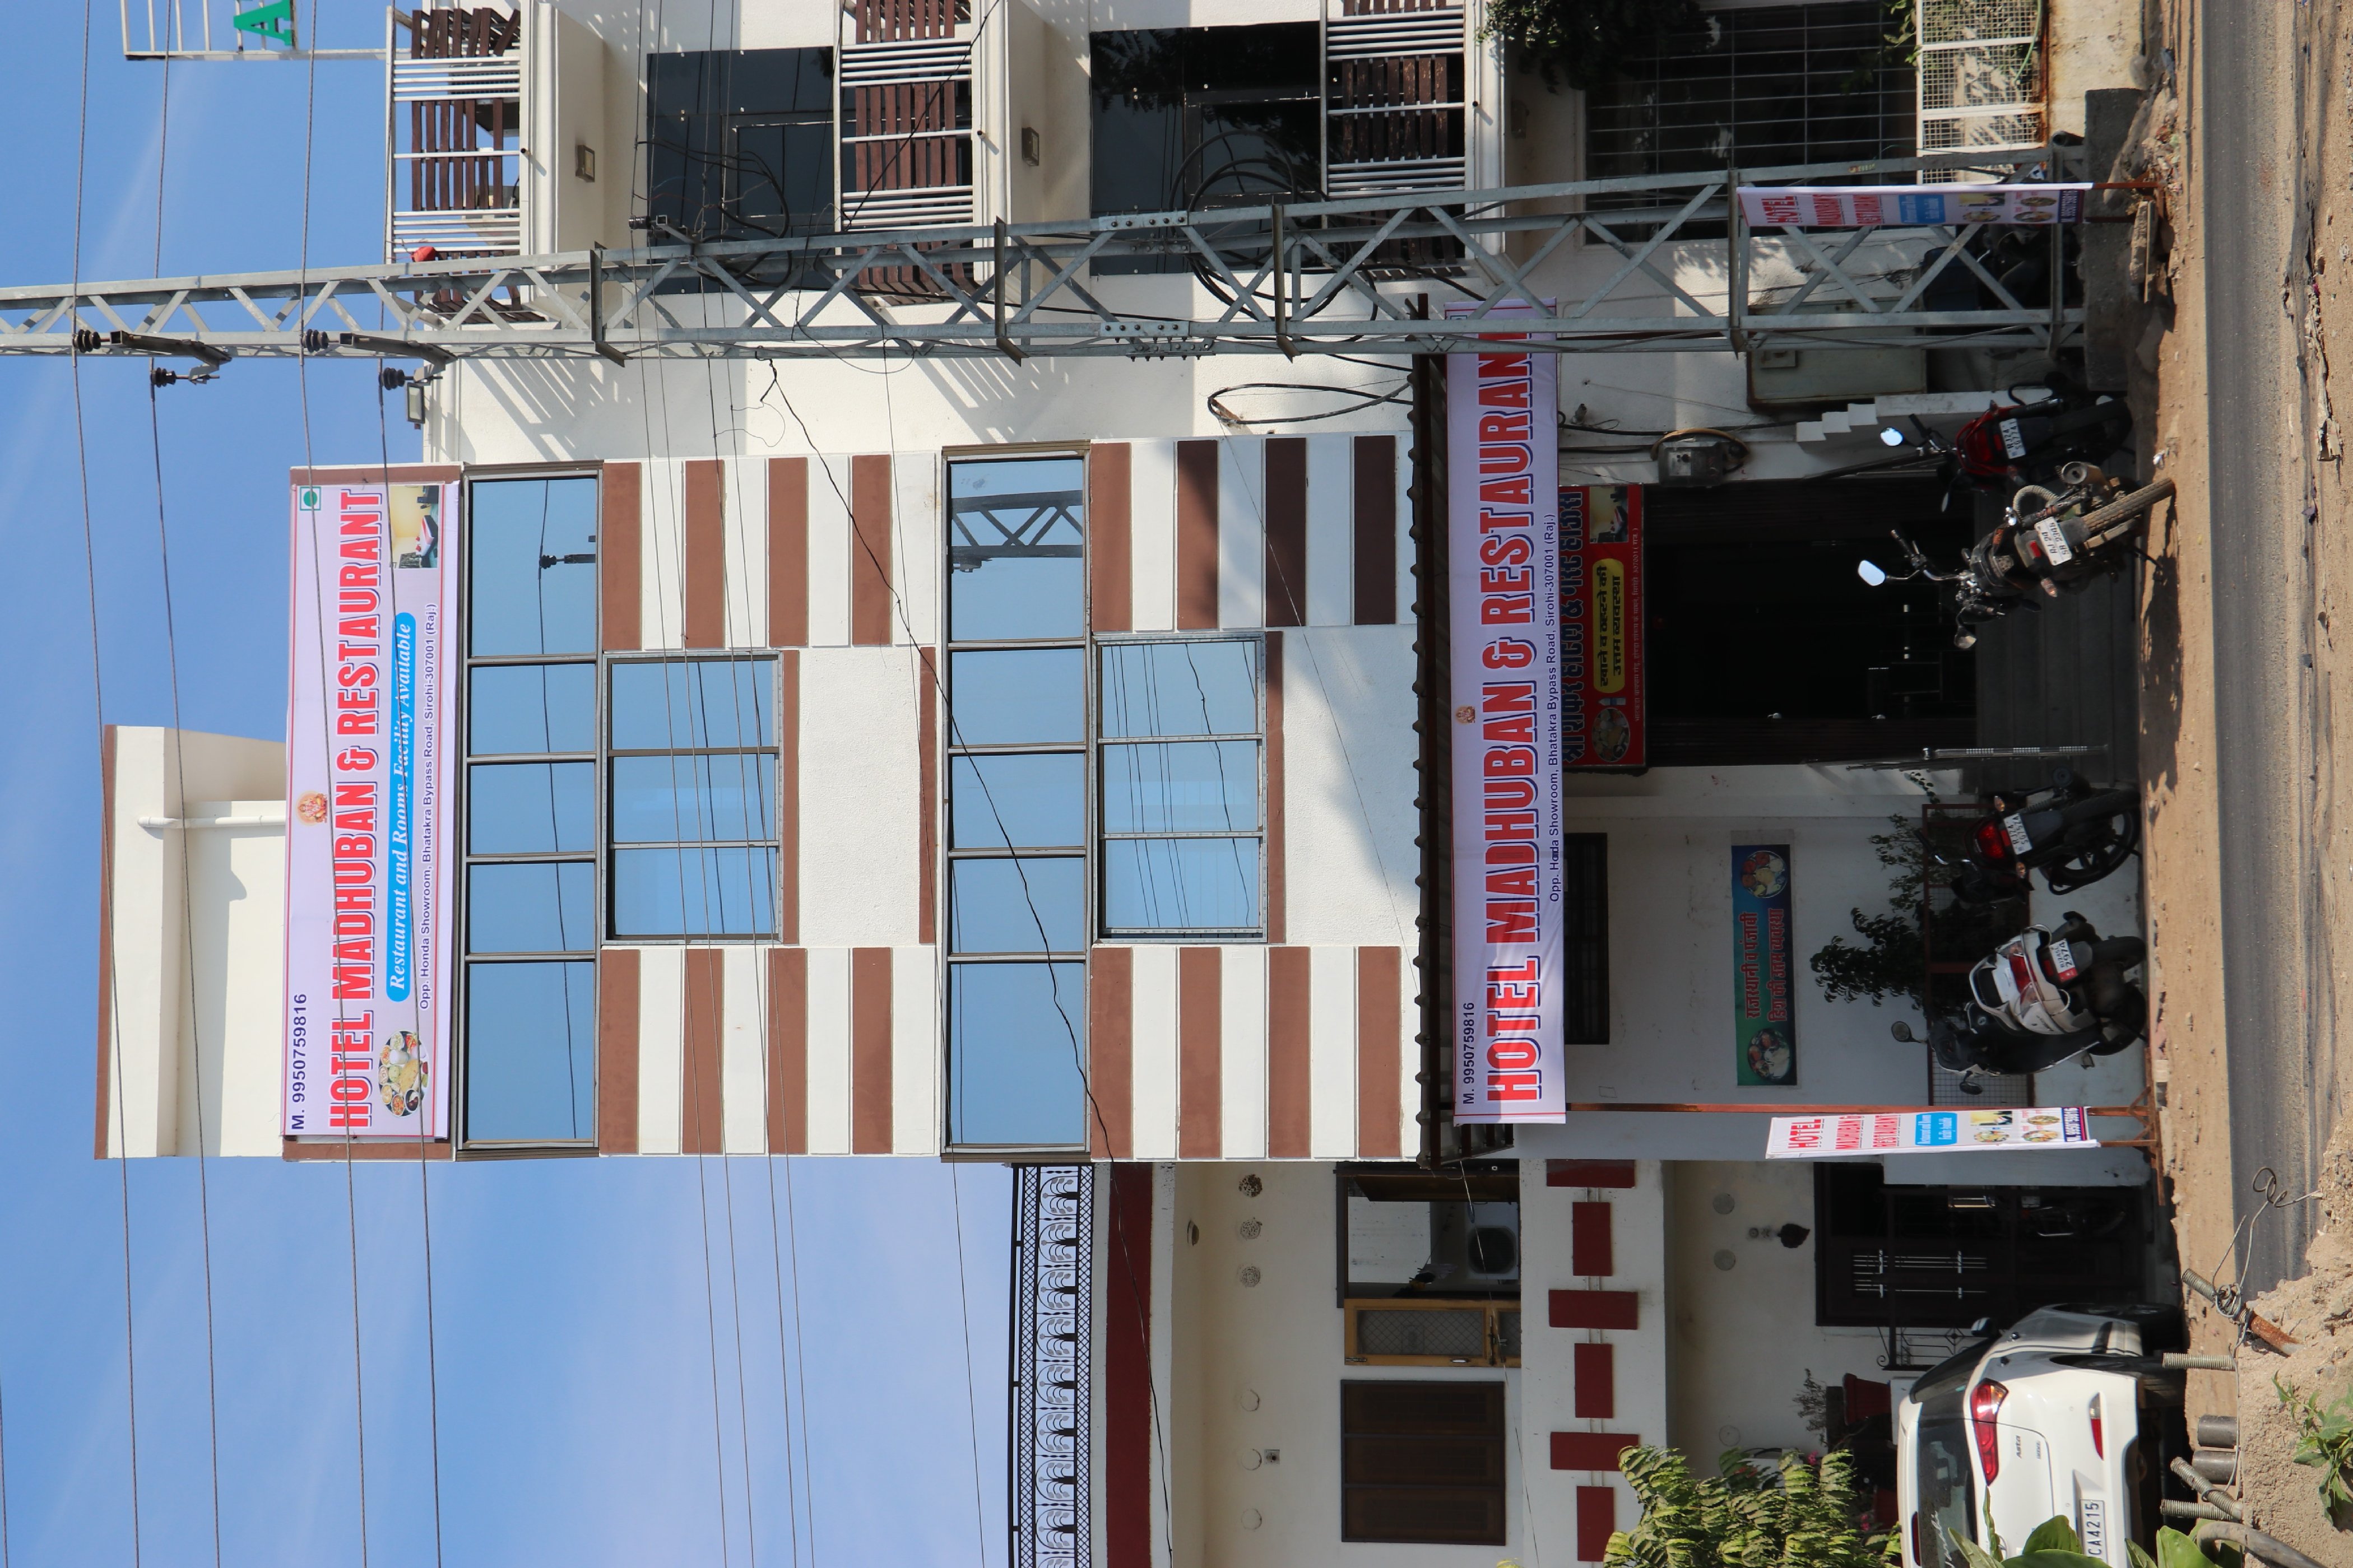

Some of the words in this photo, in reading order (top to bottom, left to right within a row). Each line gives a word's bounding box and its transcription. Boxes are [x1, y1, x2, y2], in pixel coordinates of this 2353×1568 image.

[1761, 196, 1801, 223] HOTEL
[1544, 513, 1557, 545] (Raj.)
[1544, 548, 1557, 627] Sirohi-307001
[1595, 565, 1608, 587] की
[336, 489, 382, 736] RESTAURANT
[424, 603, 438, 635] (Raj.)
[1611, 574, 1621, 636] व्यवस्था
[395, 622, 412, 708] Available
[1481, 637, 1537, 670] &
[1545, 630, 1558, 664] Road,
[1596, 649, 1608, 687] खाने
[1612, 638, 1622, 677] उत्तम
[423, 638, 435, 720] Sirohi-307001
[1546, 667, 1560, 710] Bypass
[336, 746, 379, 772] &
[392, 710, 413, 778] Facility
[423, 723, 436, 758] Road,
[1547, 713, 1559, 766] Bhatakra
[423, 761, 436, 806] Bypass
[1547, 769, 1561, 837] Showroom,
[392, 783, 410, 845] Rooms
[1481, 680, 1540, 944] MADHUBAN
[421, 808, 433, 862] Bhatakra
[391, 849, 408, 885] and
[1549, 873, 1562, 902] Opp.
[331, 781, 377, 1000] MADHUBAN
[420, 866, 433, 934] Showroom,
[389, 890, 407, 990] Restaurant
[1739, 911, 1758, 950] पंजाबी
[420, 937, 431, 978] Honda
[419, 980, 433, 1010] Opp.
[1739, 963, 1760, 1019] राजस्थानी
[292, 993, 308, 1103] 9950759816
[1462, 1002, 1475, 1085] 9950759816
[1486, 955, 1542, 1102] HOTEL
[329, 1010, 373, 1128] HOTEL
[1463, 1088, 1475, 1105] M.
[291, 1109, 306, 1130] M.
[1787, 1118, 1825, 1149] HOTEL
[1835, 1120, 1864, 1150] MADHUBAN
[1872, 1114, 1901, 1148] RESTAURANT
[2084, 1502, 2102, 1556] CA4215
